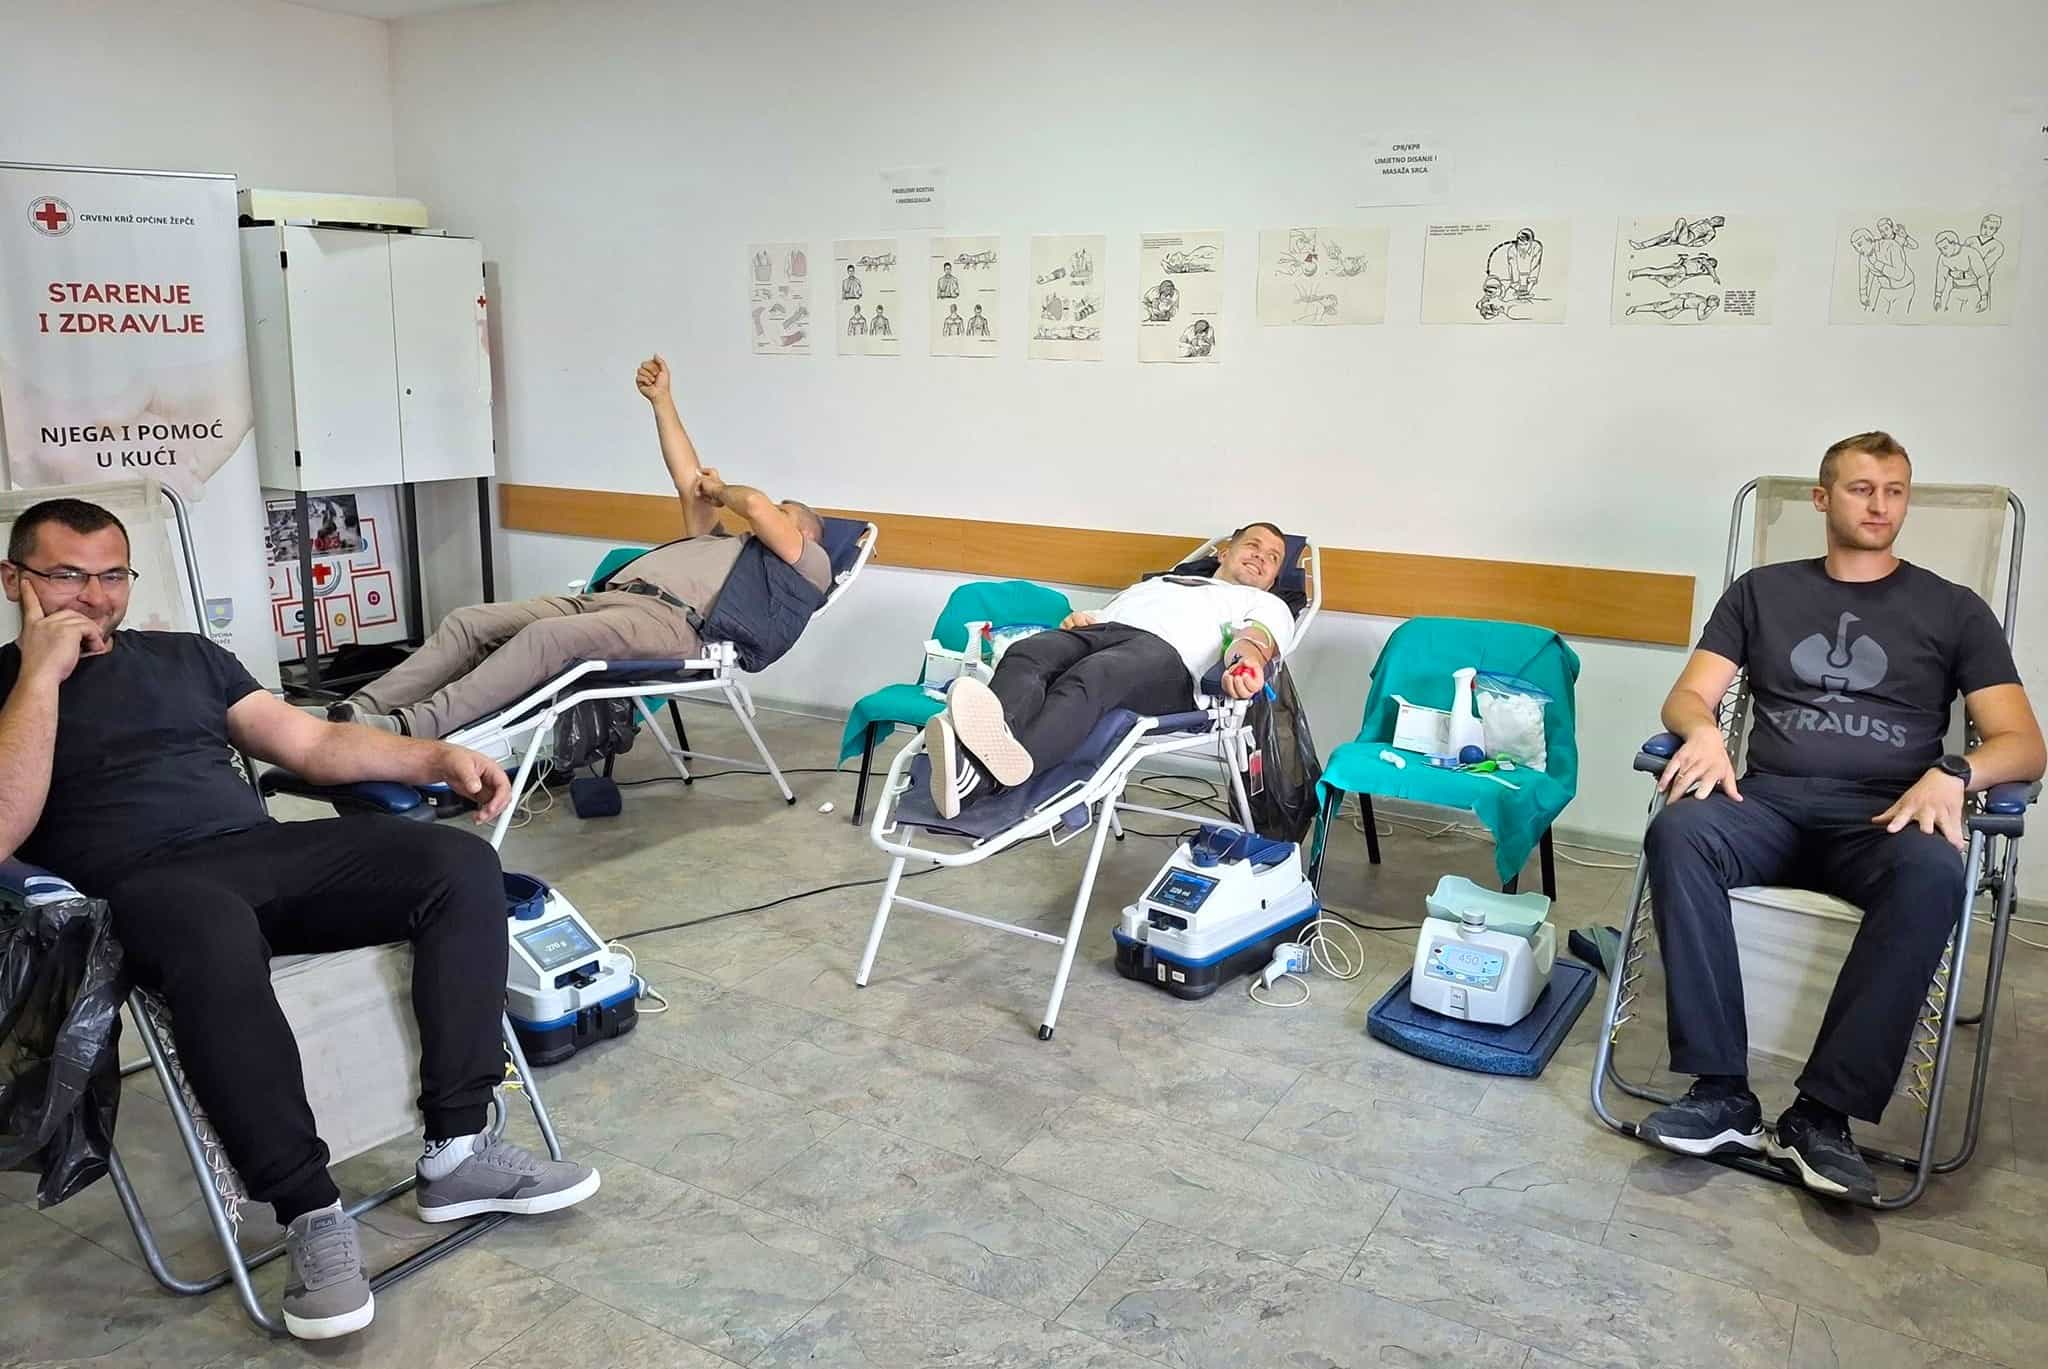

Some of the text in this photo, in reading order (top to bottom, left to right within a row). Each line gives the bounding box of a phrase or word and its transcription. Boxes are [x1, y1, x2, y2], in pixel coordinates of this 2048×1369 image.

[79, 213, 113, 223] CRVENI
[114, 213, 134, 224] KRIŽ
[48, 282, 191, 304] STARENJE
[39, 313, 205, 334] I ZDRAVLJE
[40, 419, 224, 448] NJEGA I POMOĆ
[96, 446, 177, 468] U KUĆI
